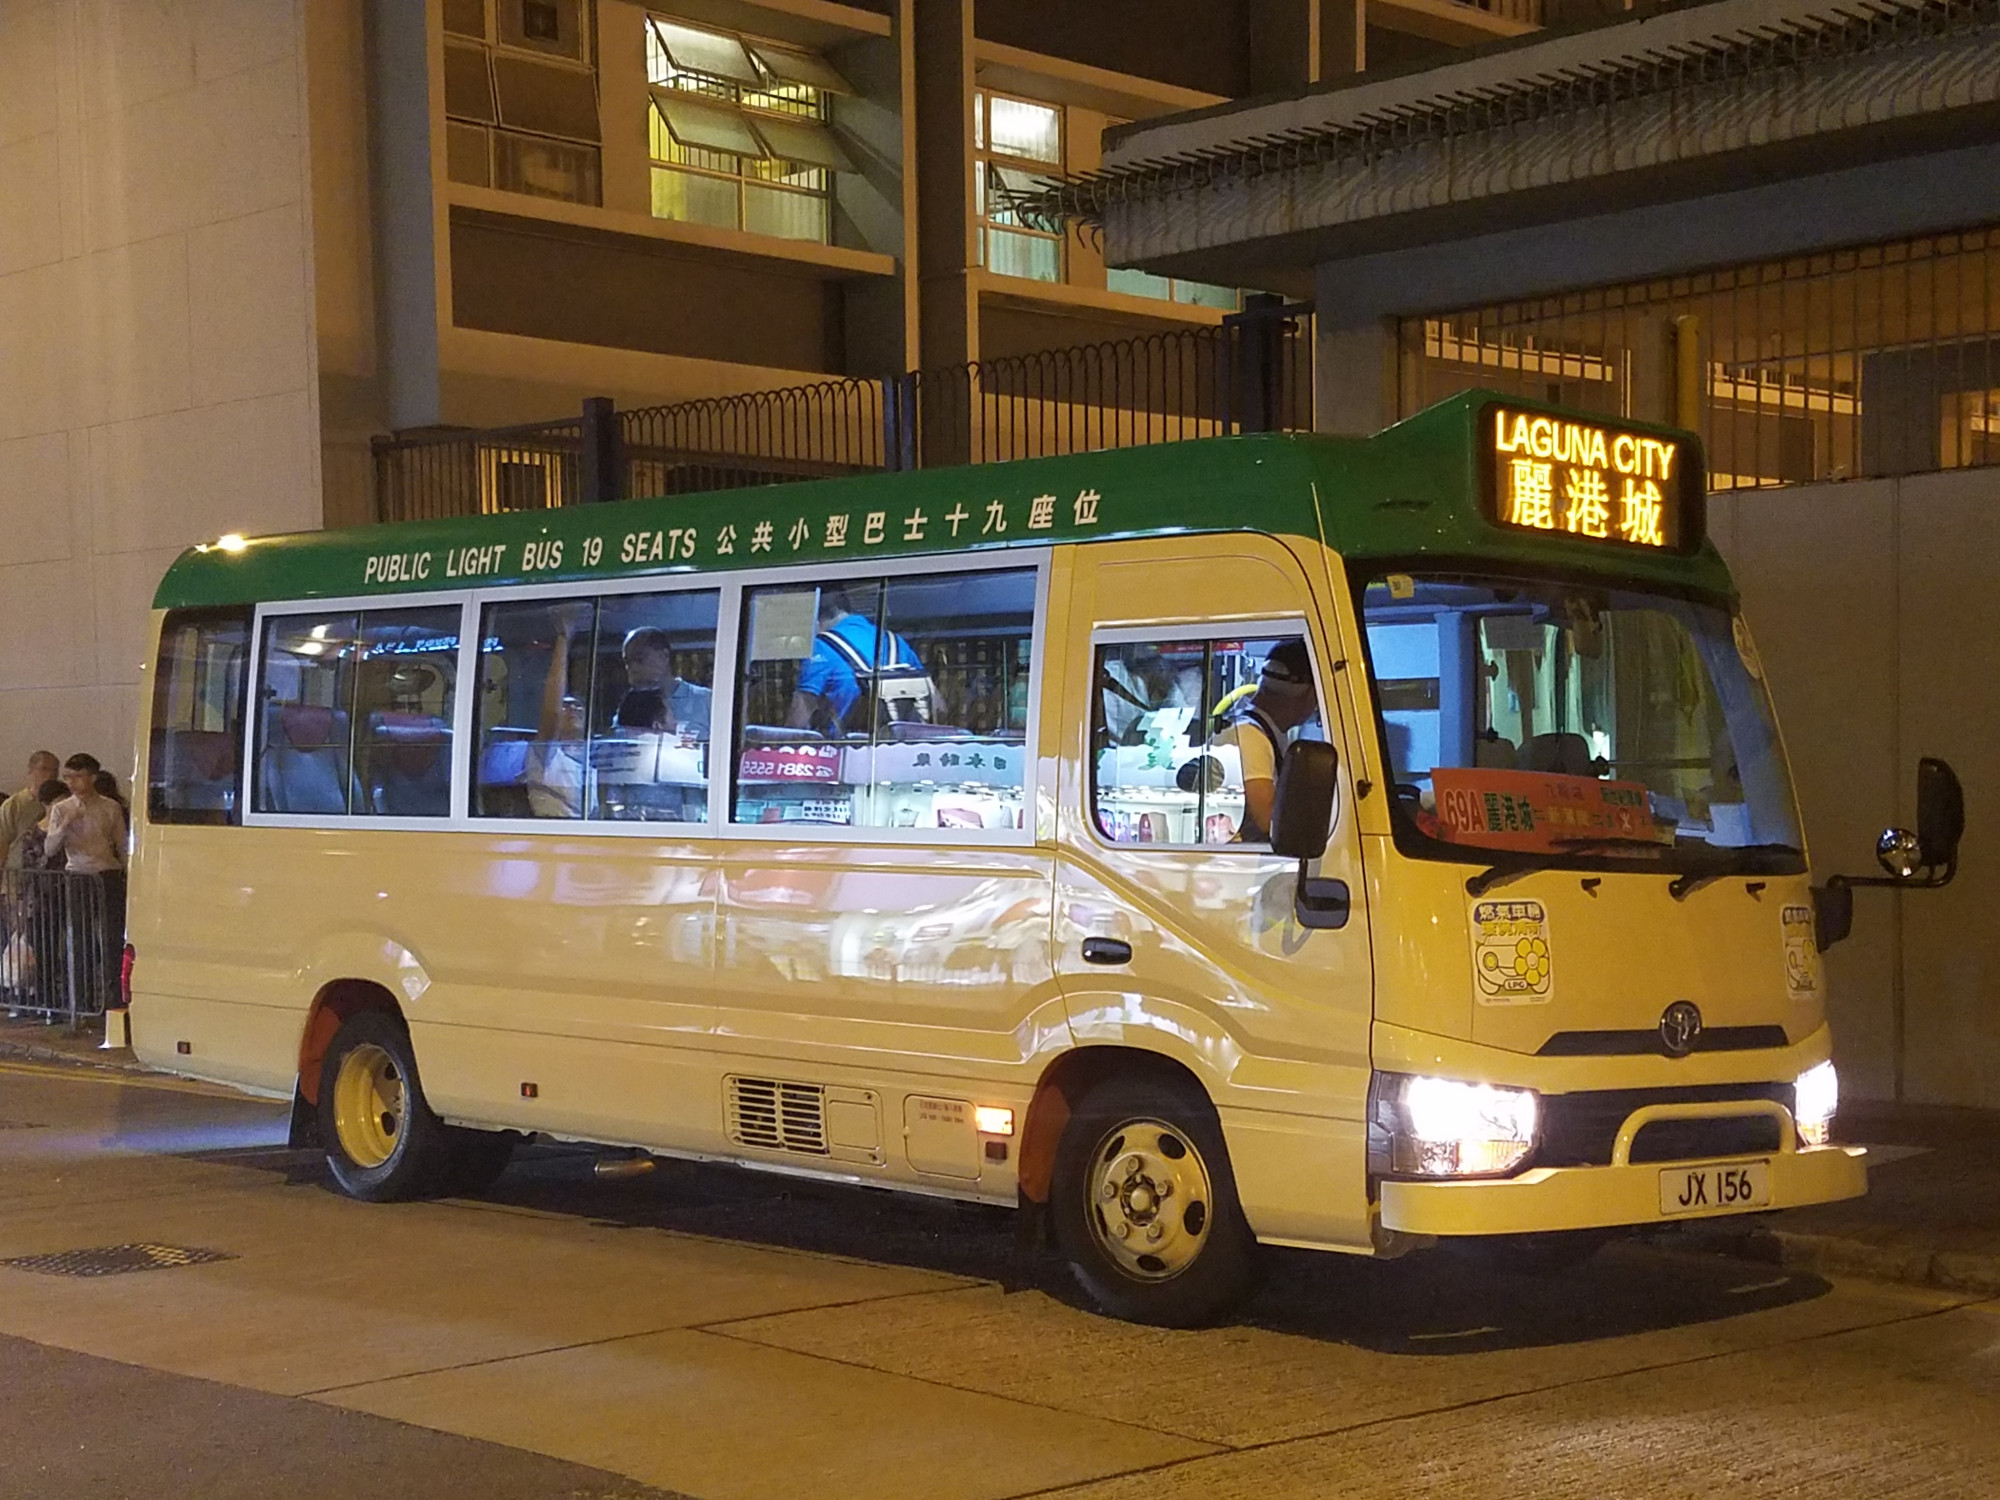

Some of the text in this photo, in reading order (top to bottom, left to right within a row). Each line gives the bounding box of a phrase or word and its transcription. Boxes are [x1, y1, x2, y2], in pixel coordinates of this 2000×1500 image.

[1496, 410, 1675, 481] LAGUNA CITY
[716, 489, 1101, 555] 公共小型巴士十九座位
[1510, 457, 1662, 547] 麗港城
[364, 528, 696, 583] PUBLIC LIGHT BUS 19 SEATS
[1443, 789, 1486, 834] 69A
[1507, 981, 1525, 989] LPG
[1678, 1170, 1752, 1206] JX 156
